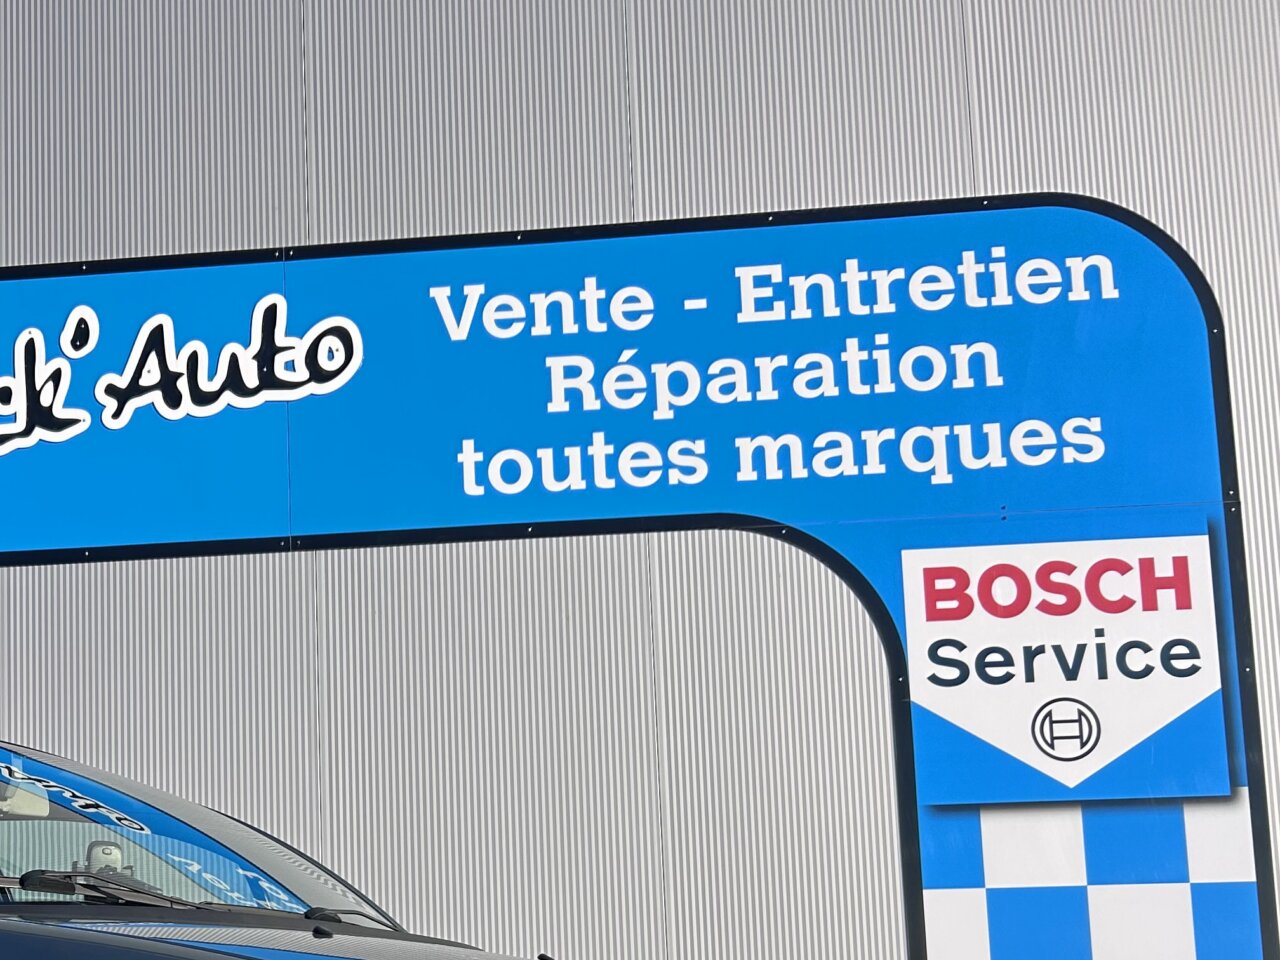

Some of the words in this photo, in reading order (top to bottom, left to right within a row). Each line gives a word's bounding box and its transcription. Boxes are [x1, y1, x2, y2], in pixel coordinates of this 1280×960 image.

[429, 276, 654, 341] Vente
[734, 246, 1120, 323] Entretien
[545, 333, 1004, 420] Réparation
[457, 431, 709, 496] toutes
[735, 417, 1105, 485] marques
[923, 556, 1192, 622] BOSCH
[927, 628, 1202, 687] Service
